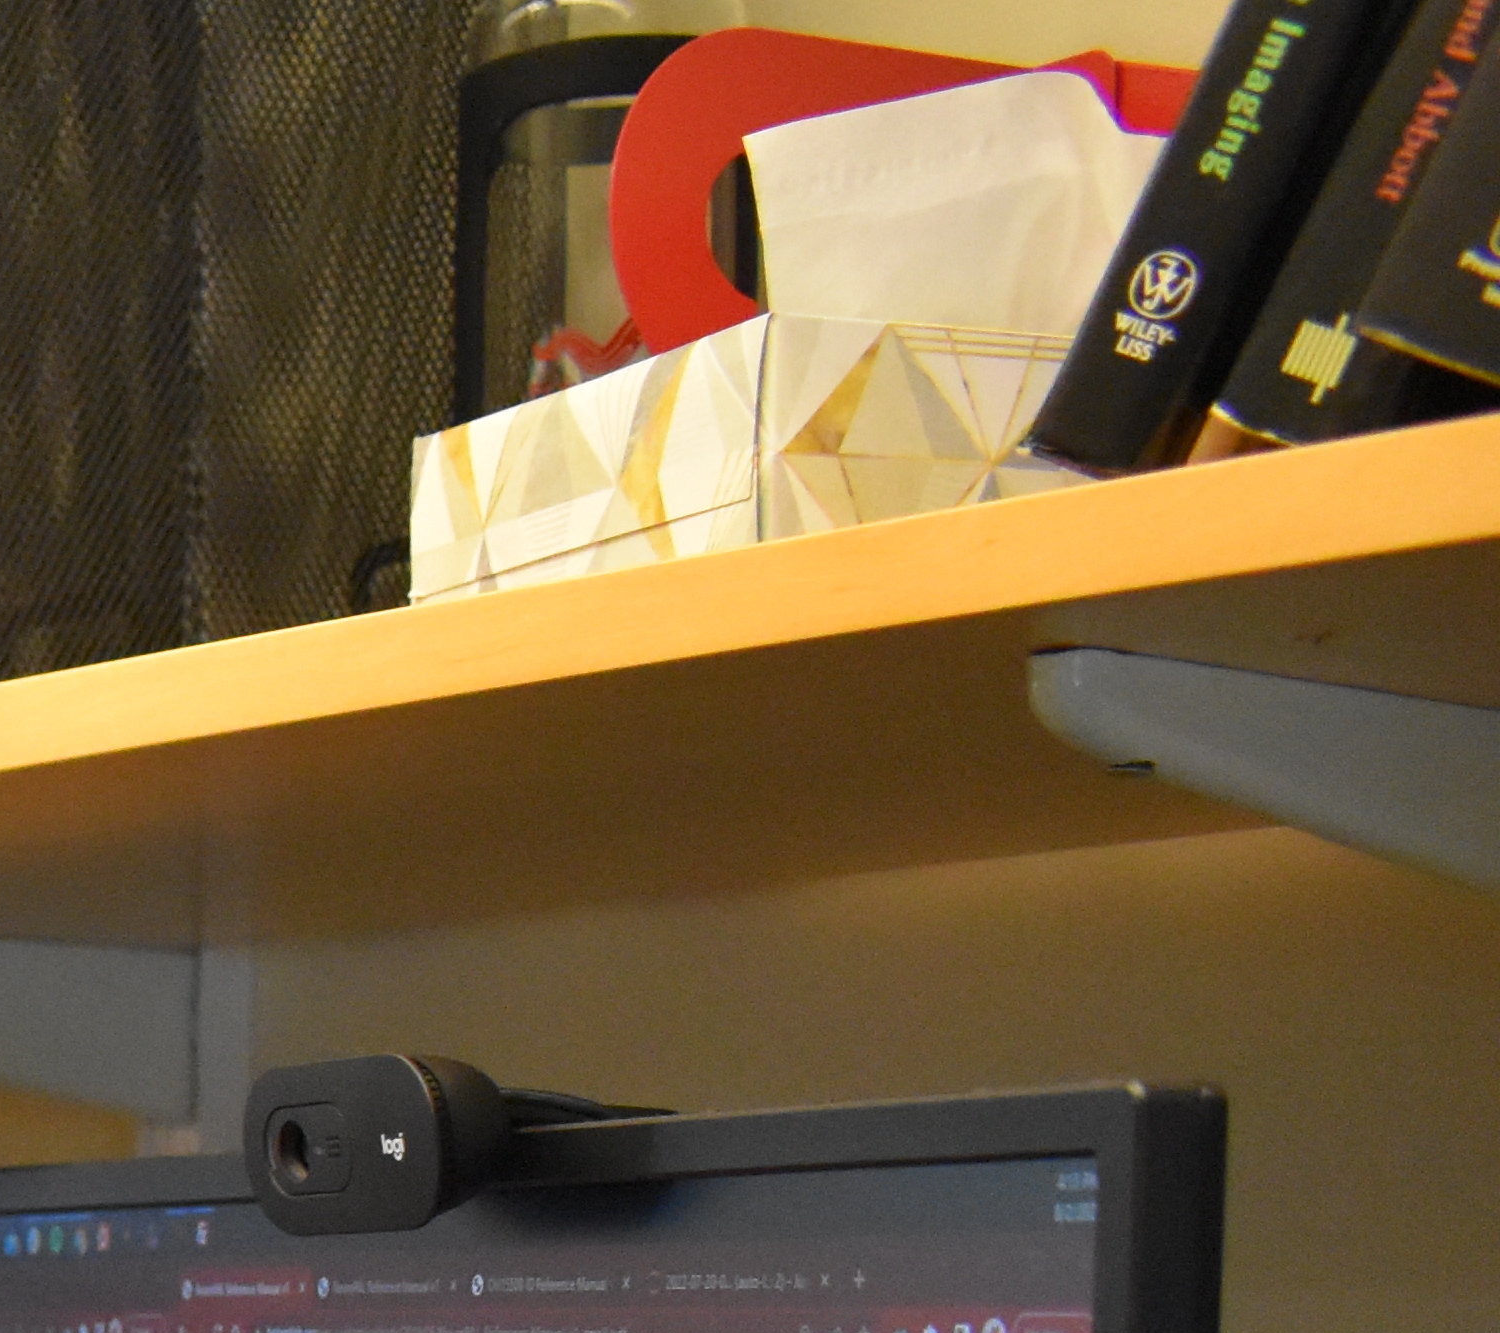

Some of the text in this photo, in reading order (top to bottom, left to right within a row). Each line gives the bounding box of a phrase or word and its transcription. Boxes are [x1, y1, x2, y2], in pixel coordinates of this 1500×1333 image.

[1198, 18, 1305, 181] Imaging
[1113, 310, 1177, 346] WILEY-
[1114, 334, 1156, 363] LISS
[380, 1132, 406, 1161] logi
